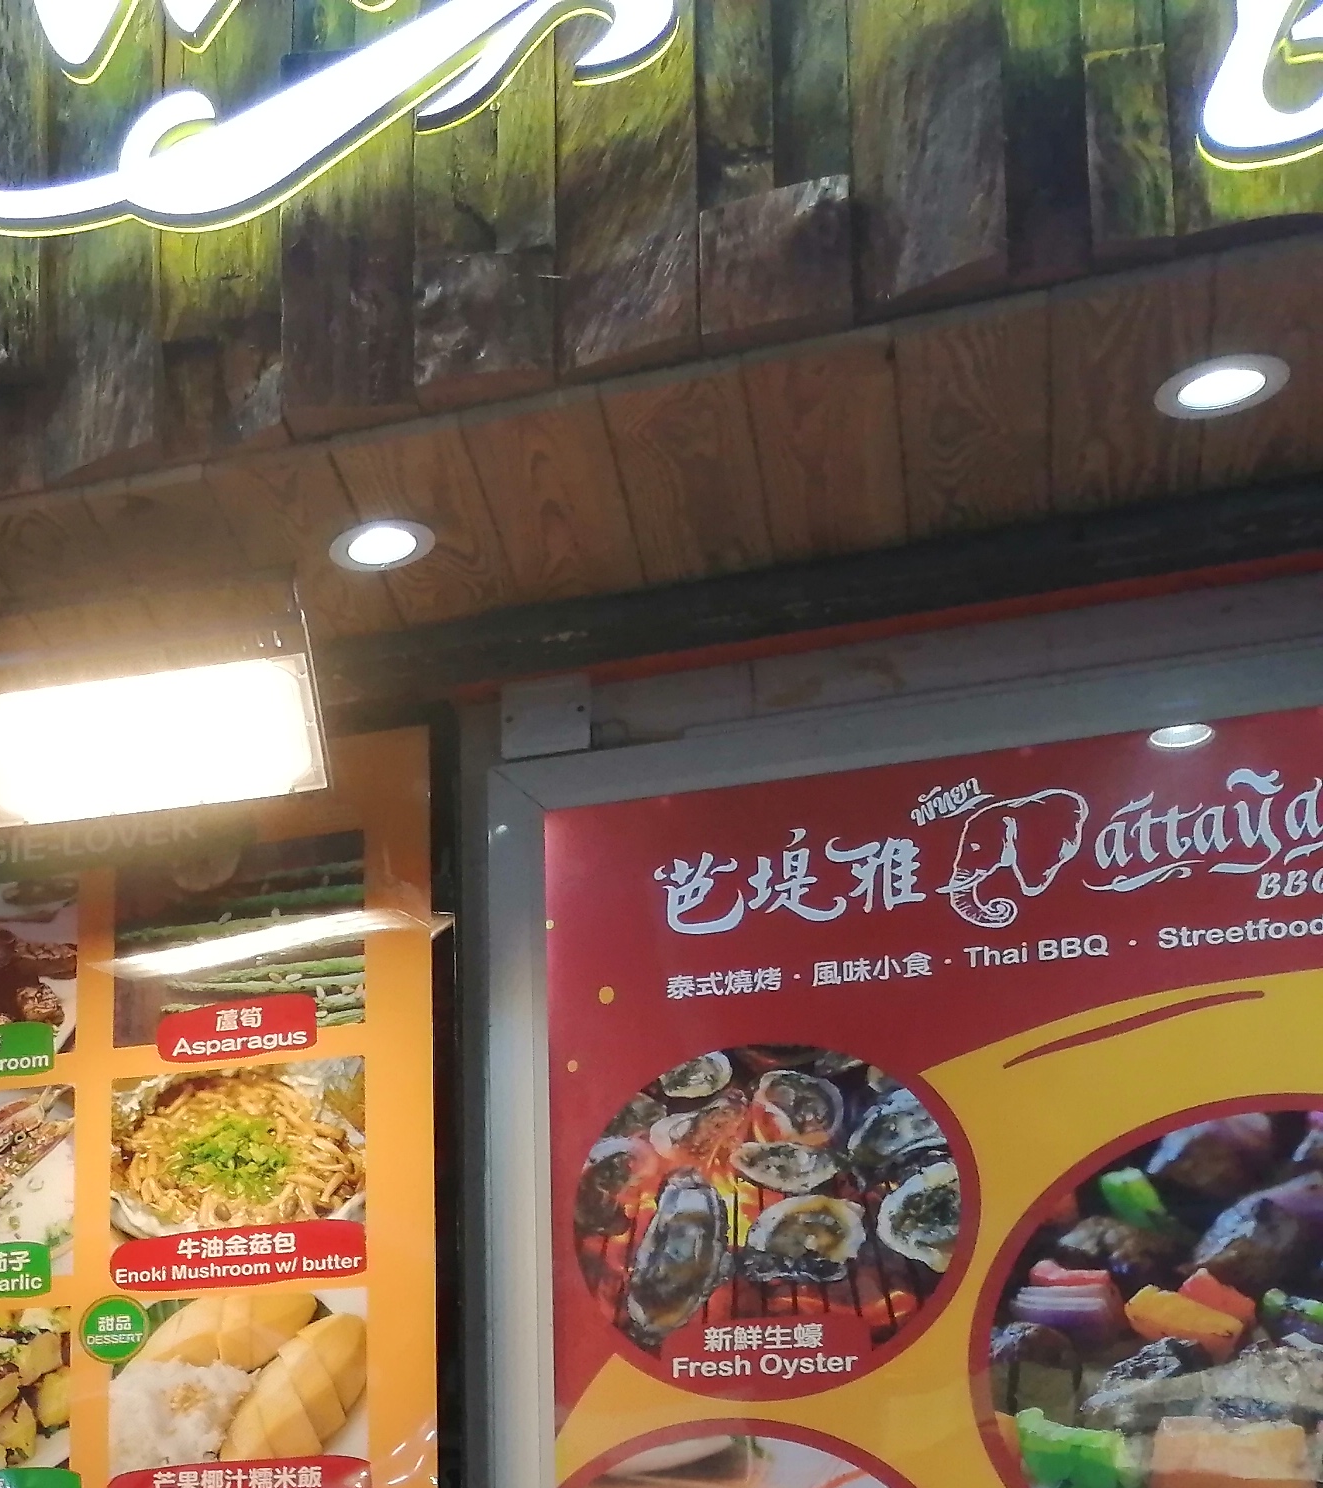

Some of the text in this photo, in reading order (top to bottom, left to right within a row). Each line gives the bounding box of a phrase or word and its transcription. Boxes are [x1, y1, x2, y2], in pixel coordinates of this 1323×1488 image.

[653, 827, 927, 935] 芭堤雅
[666, 964, 782, 1000] 泰式燒烤
[811, 950, 933, 987] 風味小食
[963, 941, 1028, 969] Thai
[1037, 934, 1110, 961] BBQ
[215, 1006, 263, 1032] 蘆筍
[172, 1030, 308, 1057] Asparagus
[177, 1231, 297, 1259] 牛油金菇包
[115, 1253, 363, 1284] Enoki Mushroom w/ butter
[97, 1314, 132, 1332] 甜品
[703, 1322, 824, 1352] 新鮮生蠔
[86, 1332, 144, 1346] DESSERT
[672, 1348, 858, 1380] Fresh Oyster
